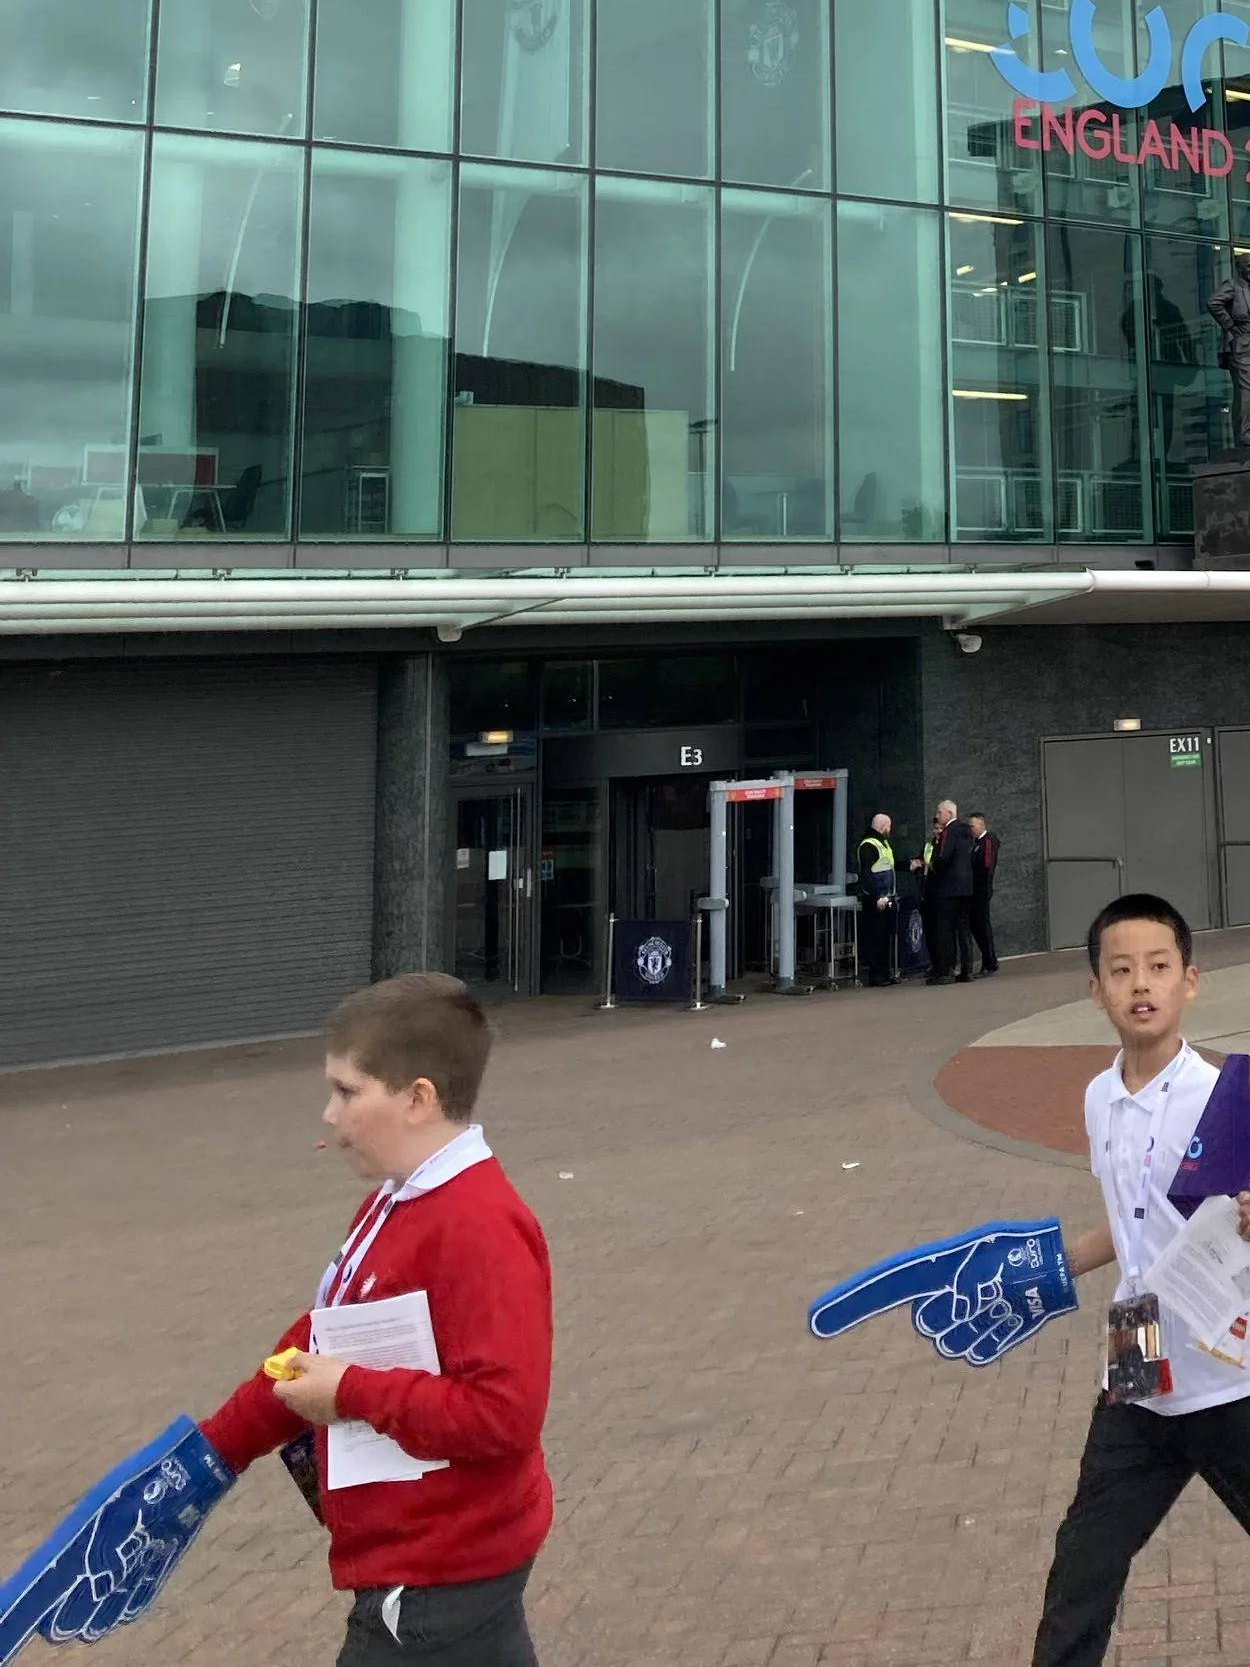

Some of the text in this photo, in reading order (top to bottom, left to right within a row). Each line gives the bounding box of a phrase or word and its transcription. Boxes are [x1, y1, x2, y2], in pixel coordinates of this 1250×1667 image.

[1012, 98, 1234, 179] ENGLAND
[680, 746, 703, 766] E3
[1169, 737, 1200, 753] EX11
[1024, 1285, 1046, 1319] VISA
